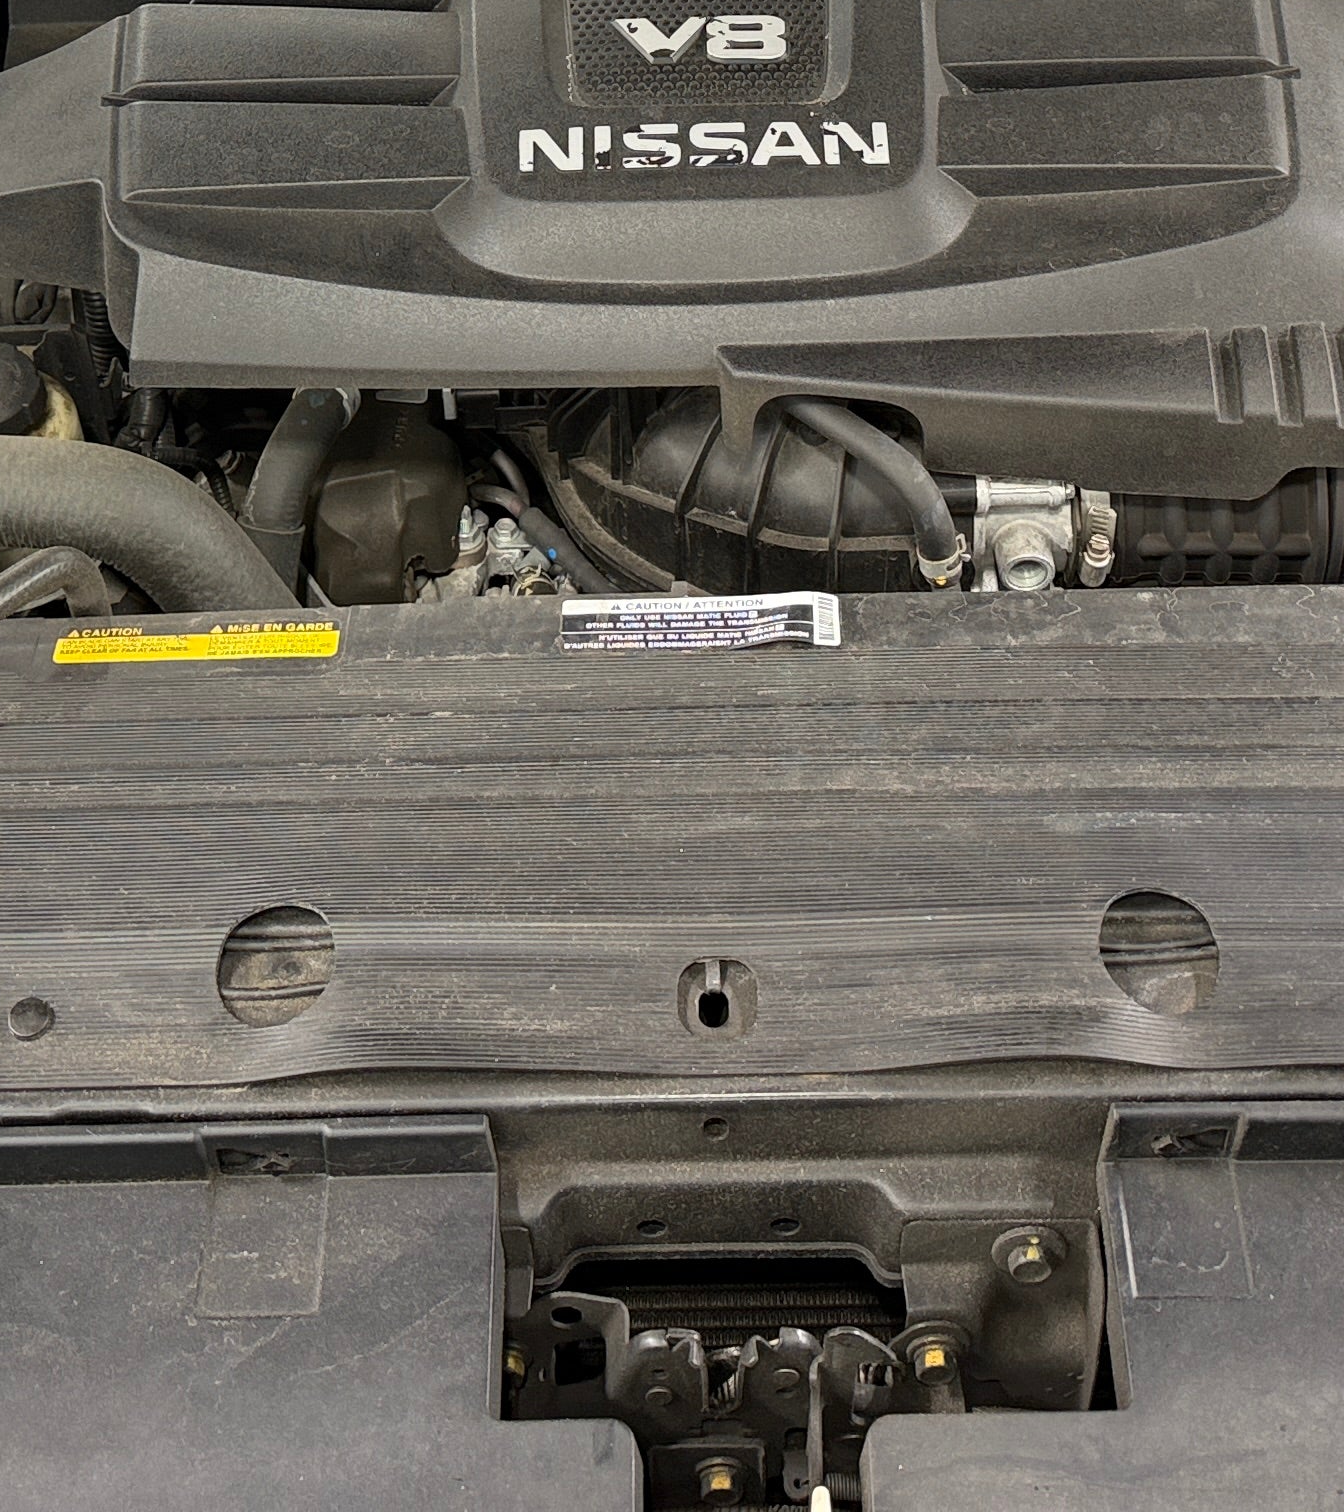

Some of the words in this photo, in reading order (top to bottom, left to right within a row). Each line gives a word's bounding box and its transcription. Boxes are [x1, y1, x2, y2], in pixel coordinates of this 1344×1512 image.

[611, 14, 787, 65] V8
[518, 121, 891, 173] NISSAN
[626, 601, 682, 611] CAUTION
[693, 598, 764, 609] ATTENTION
[81, 628, 143, 637] CAUTION
[263, 623, 283, 632] EN
[285, 622, 334, 632] GARDE
